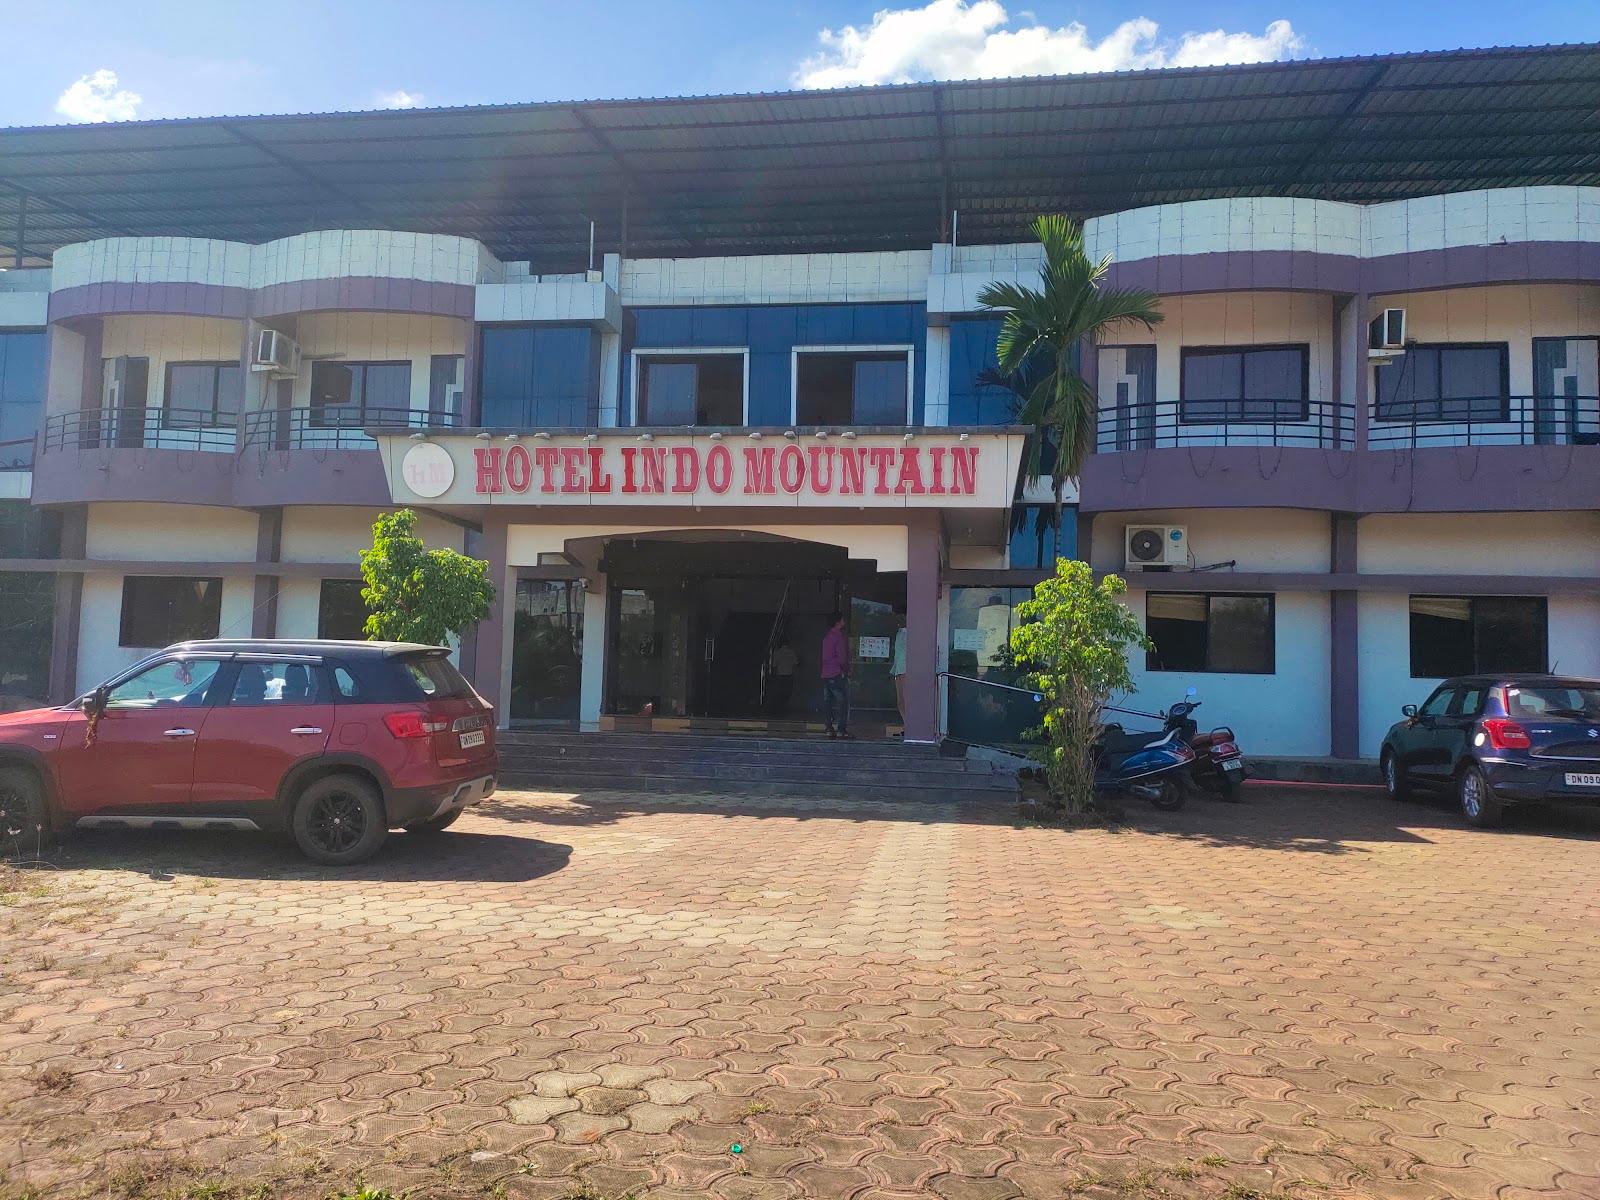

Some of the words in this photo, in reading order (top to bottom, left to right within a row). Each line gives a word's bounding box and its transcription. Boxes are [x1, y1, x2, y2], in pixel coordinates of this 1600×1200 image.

[473, 445, 612, 494] HOTEL
[621, 444, 735, 494] INDO
[742, 444, 980, 496] MOUNTAIN
